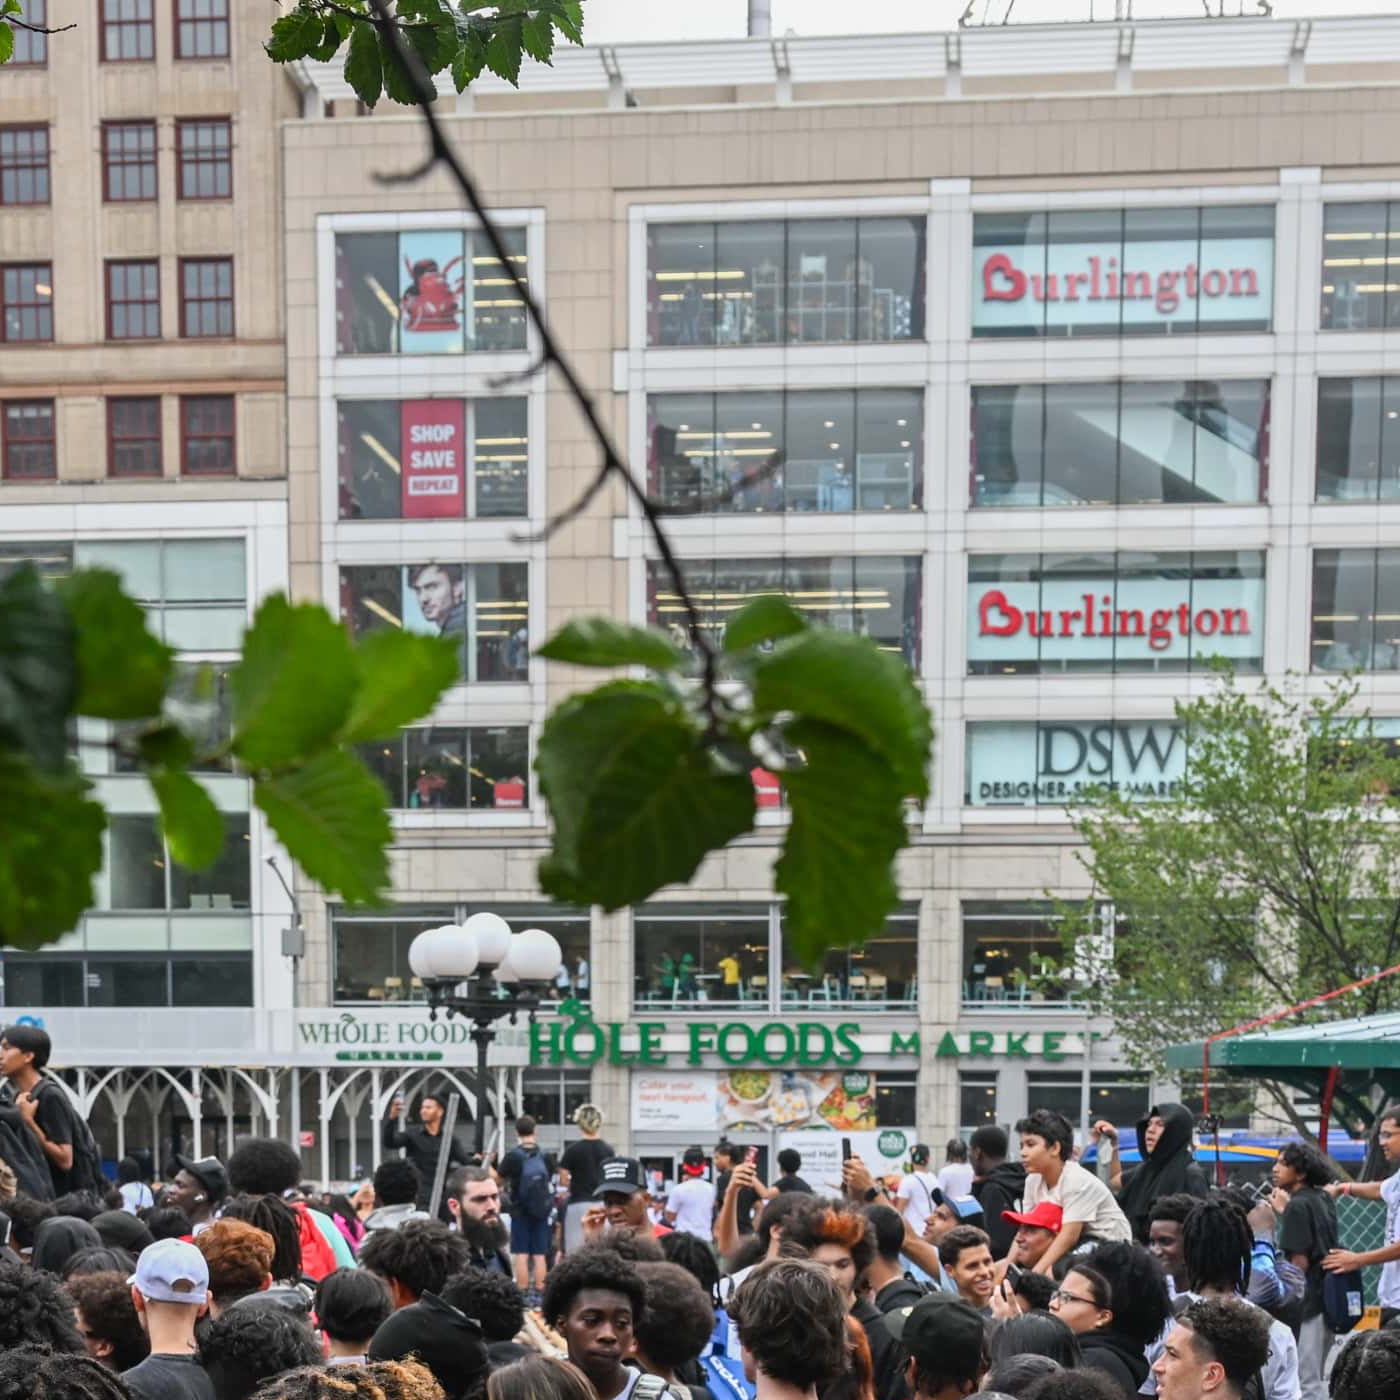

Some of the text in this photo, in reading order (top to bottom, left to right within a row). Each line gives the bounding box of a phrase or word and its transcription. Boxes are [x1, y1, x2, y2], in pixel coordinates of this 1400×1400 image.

[982, 253, 1260, 312] Burlington
[410, 424, 456, 443] SHOP
[410, 450, 456, 469] SAVE
[412, 480, 453, 491] REPEAT
[978, 590, 1250, 650] Burlington
[1039, 725, 1179, 776] DSW
[298, 1020, 390, 1044] WHOLE
[530, 1018, 667, 1066] HOLE
[687, 1022, 863, 1066] FOODS
